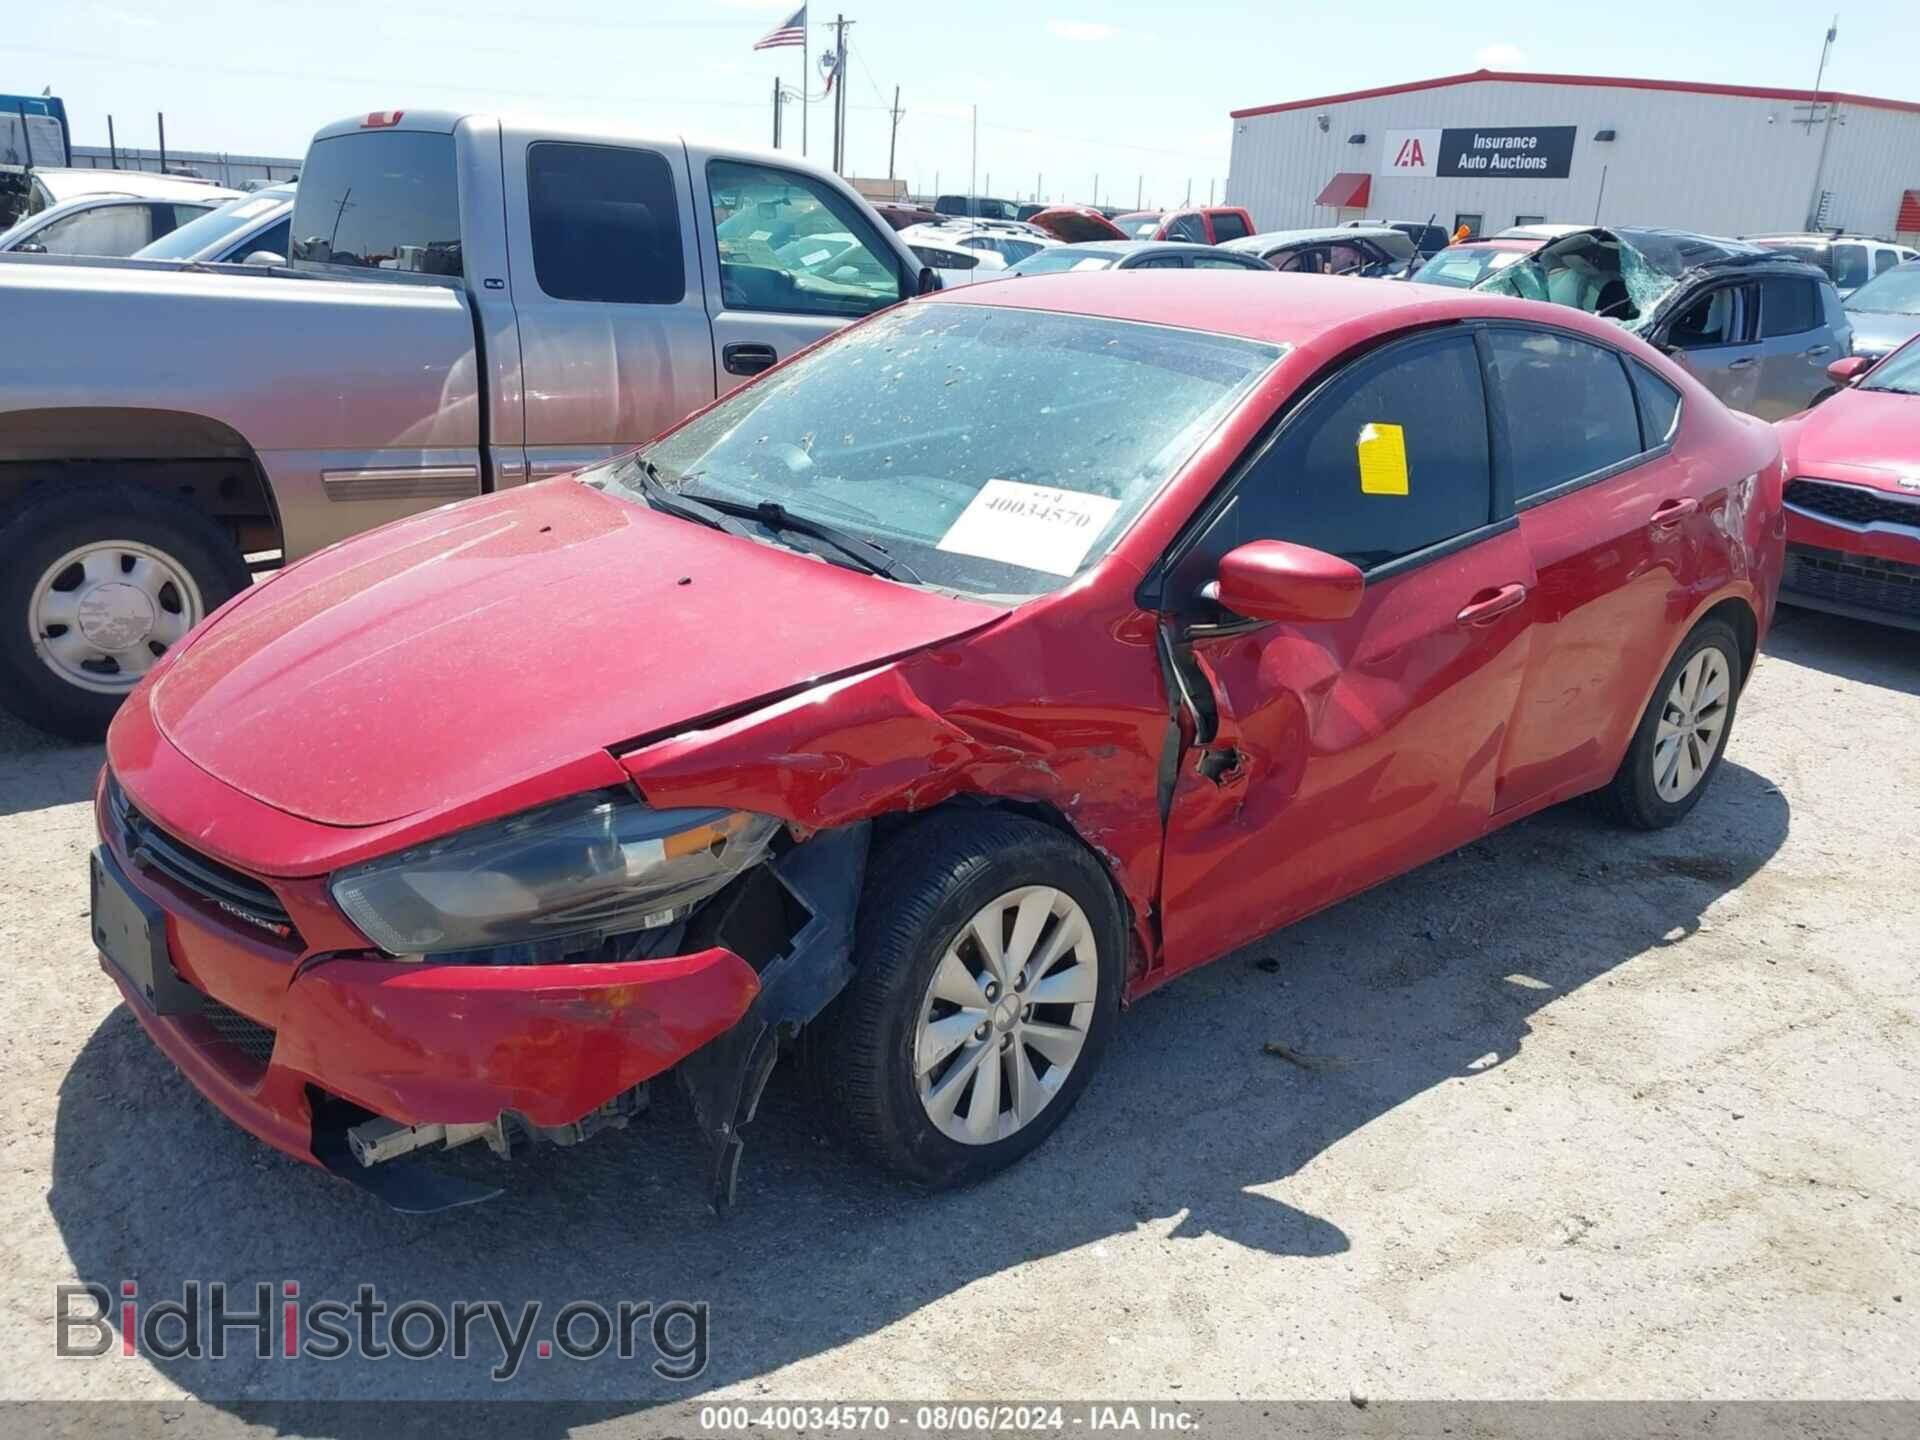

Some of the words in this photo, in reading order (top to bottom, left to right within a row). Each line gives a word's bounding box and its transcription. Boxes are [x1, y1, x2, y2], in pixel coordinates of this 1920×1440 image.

[1473, 133, 1537, 149] Insurance
[1458, 153, 1487, 169] Auto
[1490, 152, 1547, 169] Auctions
[985, 497, 1091, 528] 40034570
[219, 901, 281, 933] DODGE
